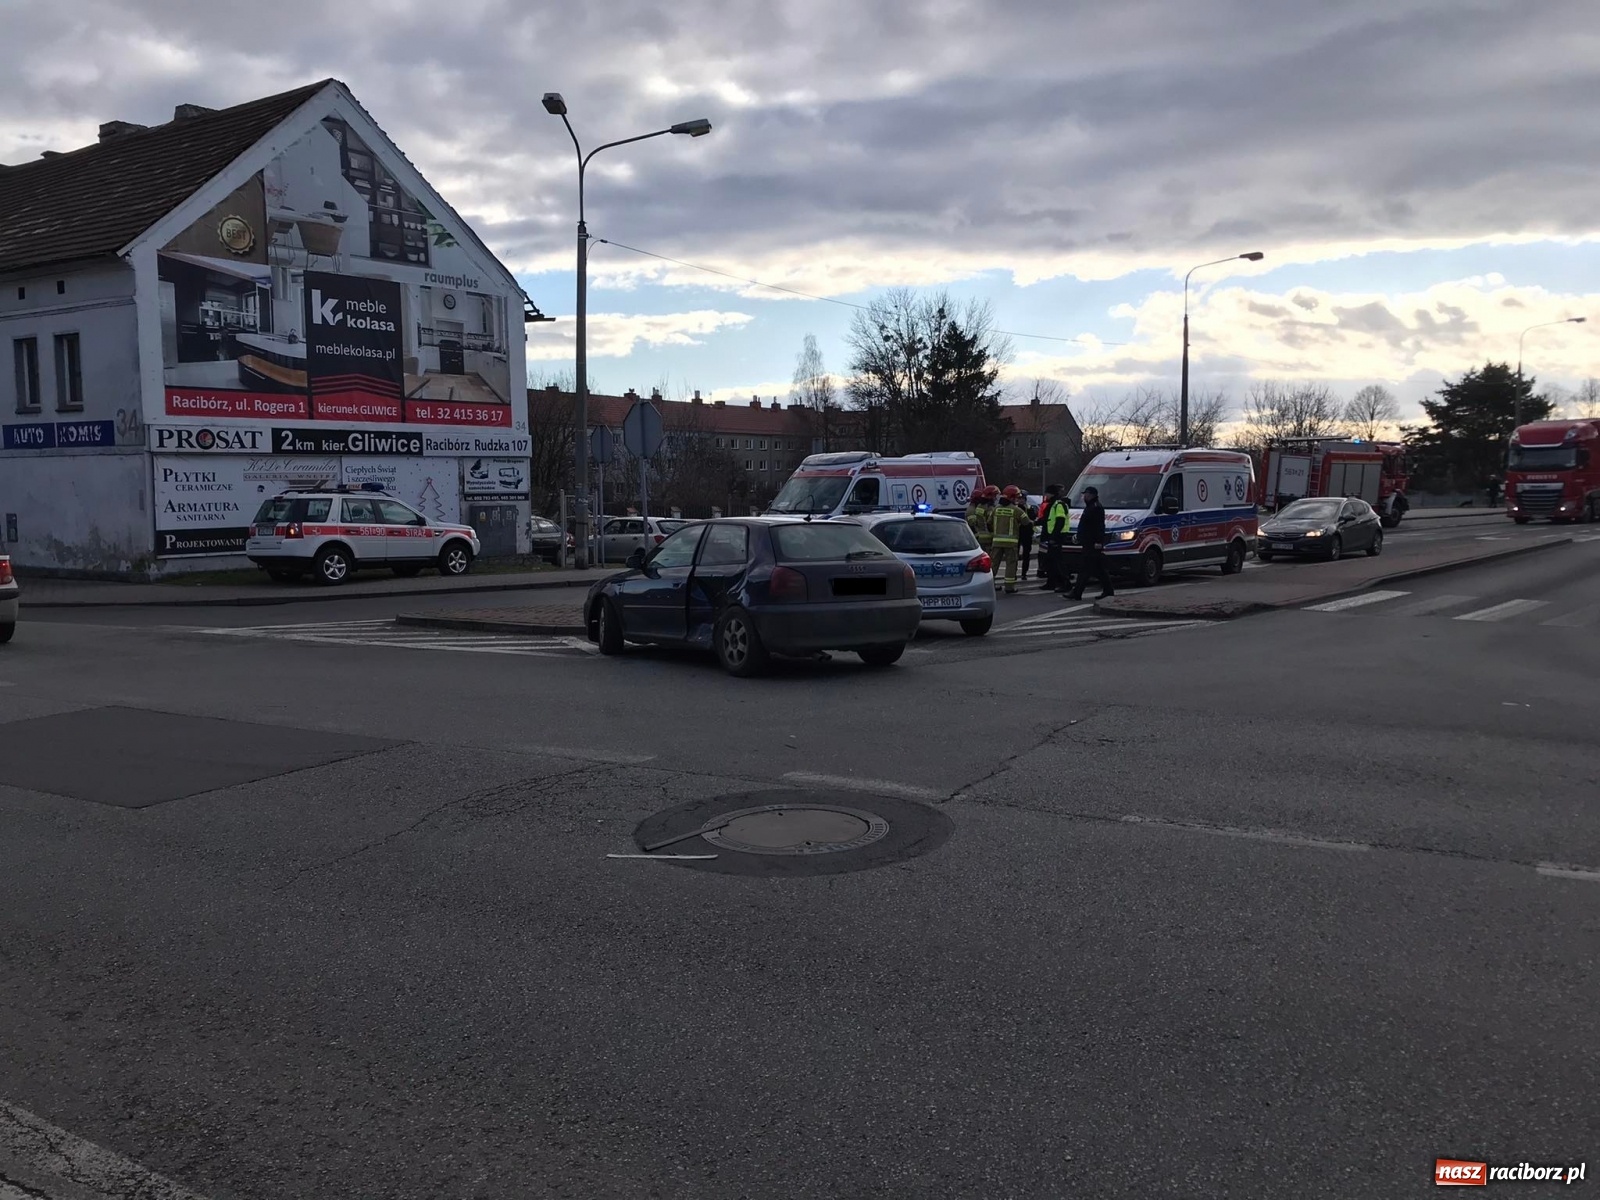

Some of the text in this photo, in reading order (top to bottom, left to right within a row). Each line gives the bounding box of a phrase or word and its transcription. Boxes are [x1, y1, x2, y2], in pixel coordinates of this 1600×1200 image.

[226, 228, 247, 240] BEST
[424, 271, 479, 289] raumplus
[346, 299, 387, 314] meble
[346, 315, 396, 332] kolasa
[315, 344, 396, 362] meblekolasa.pl
[172, 396, 305, 416] Racibórz, ul. Rogera 1
[317, 402, 398, 416] kierunek GLIWICE
[416, 406, 503, 421] tel. 32 415 36 17
[116, 408, 140, 439] 34
[515, 421, 526, 432] 34
[13, 425, 102, 444] AUTO KOMIS
[155, 428, 263, 450] PROSAT
[347, 432, 420, 453] Gliwice
[425, 437, 528, 451] Racibórz Rudzka 107
[163, 499, 240, 513] ARMATURA
